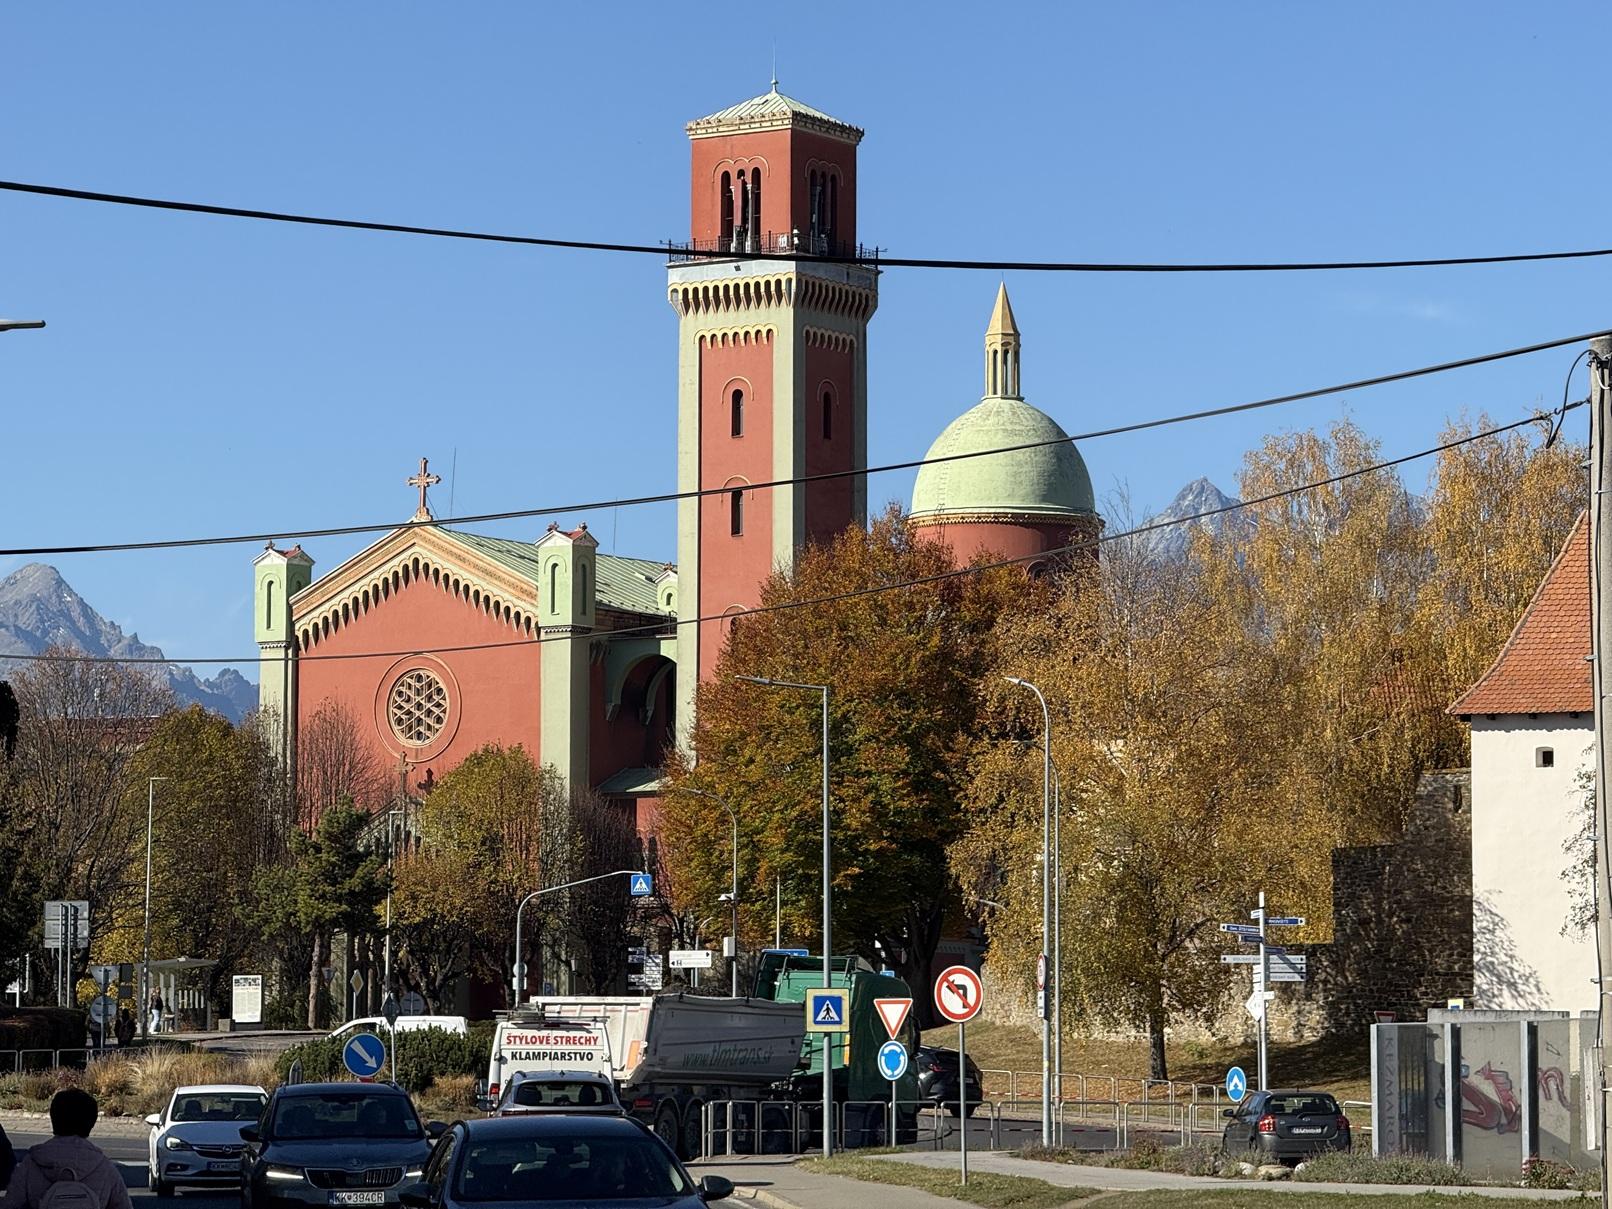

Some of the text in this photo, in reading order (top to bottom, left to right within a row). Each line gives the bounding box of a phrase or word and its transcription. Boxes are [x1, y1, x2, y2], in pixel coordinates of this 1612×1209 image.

[506, 1033, 599, 1045] ŠTÝLOVÉ STRECHY
[511, 1051, 594, 1061] KLAMPIARSTVO
